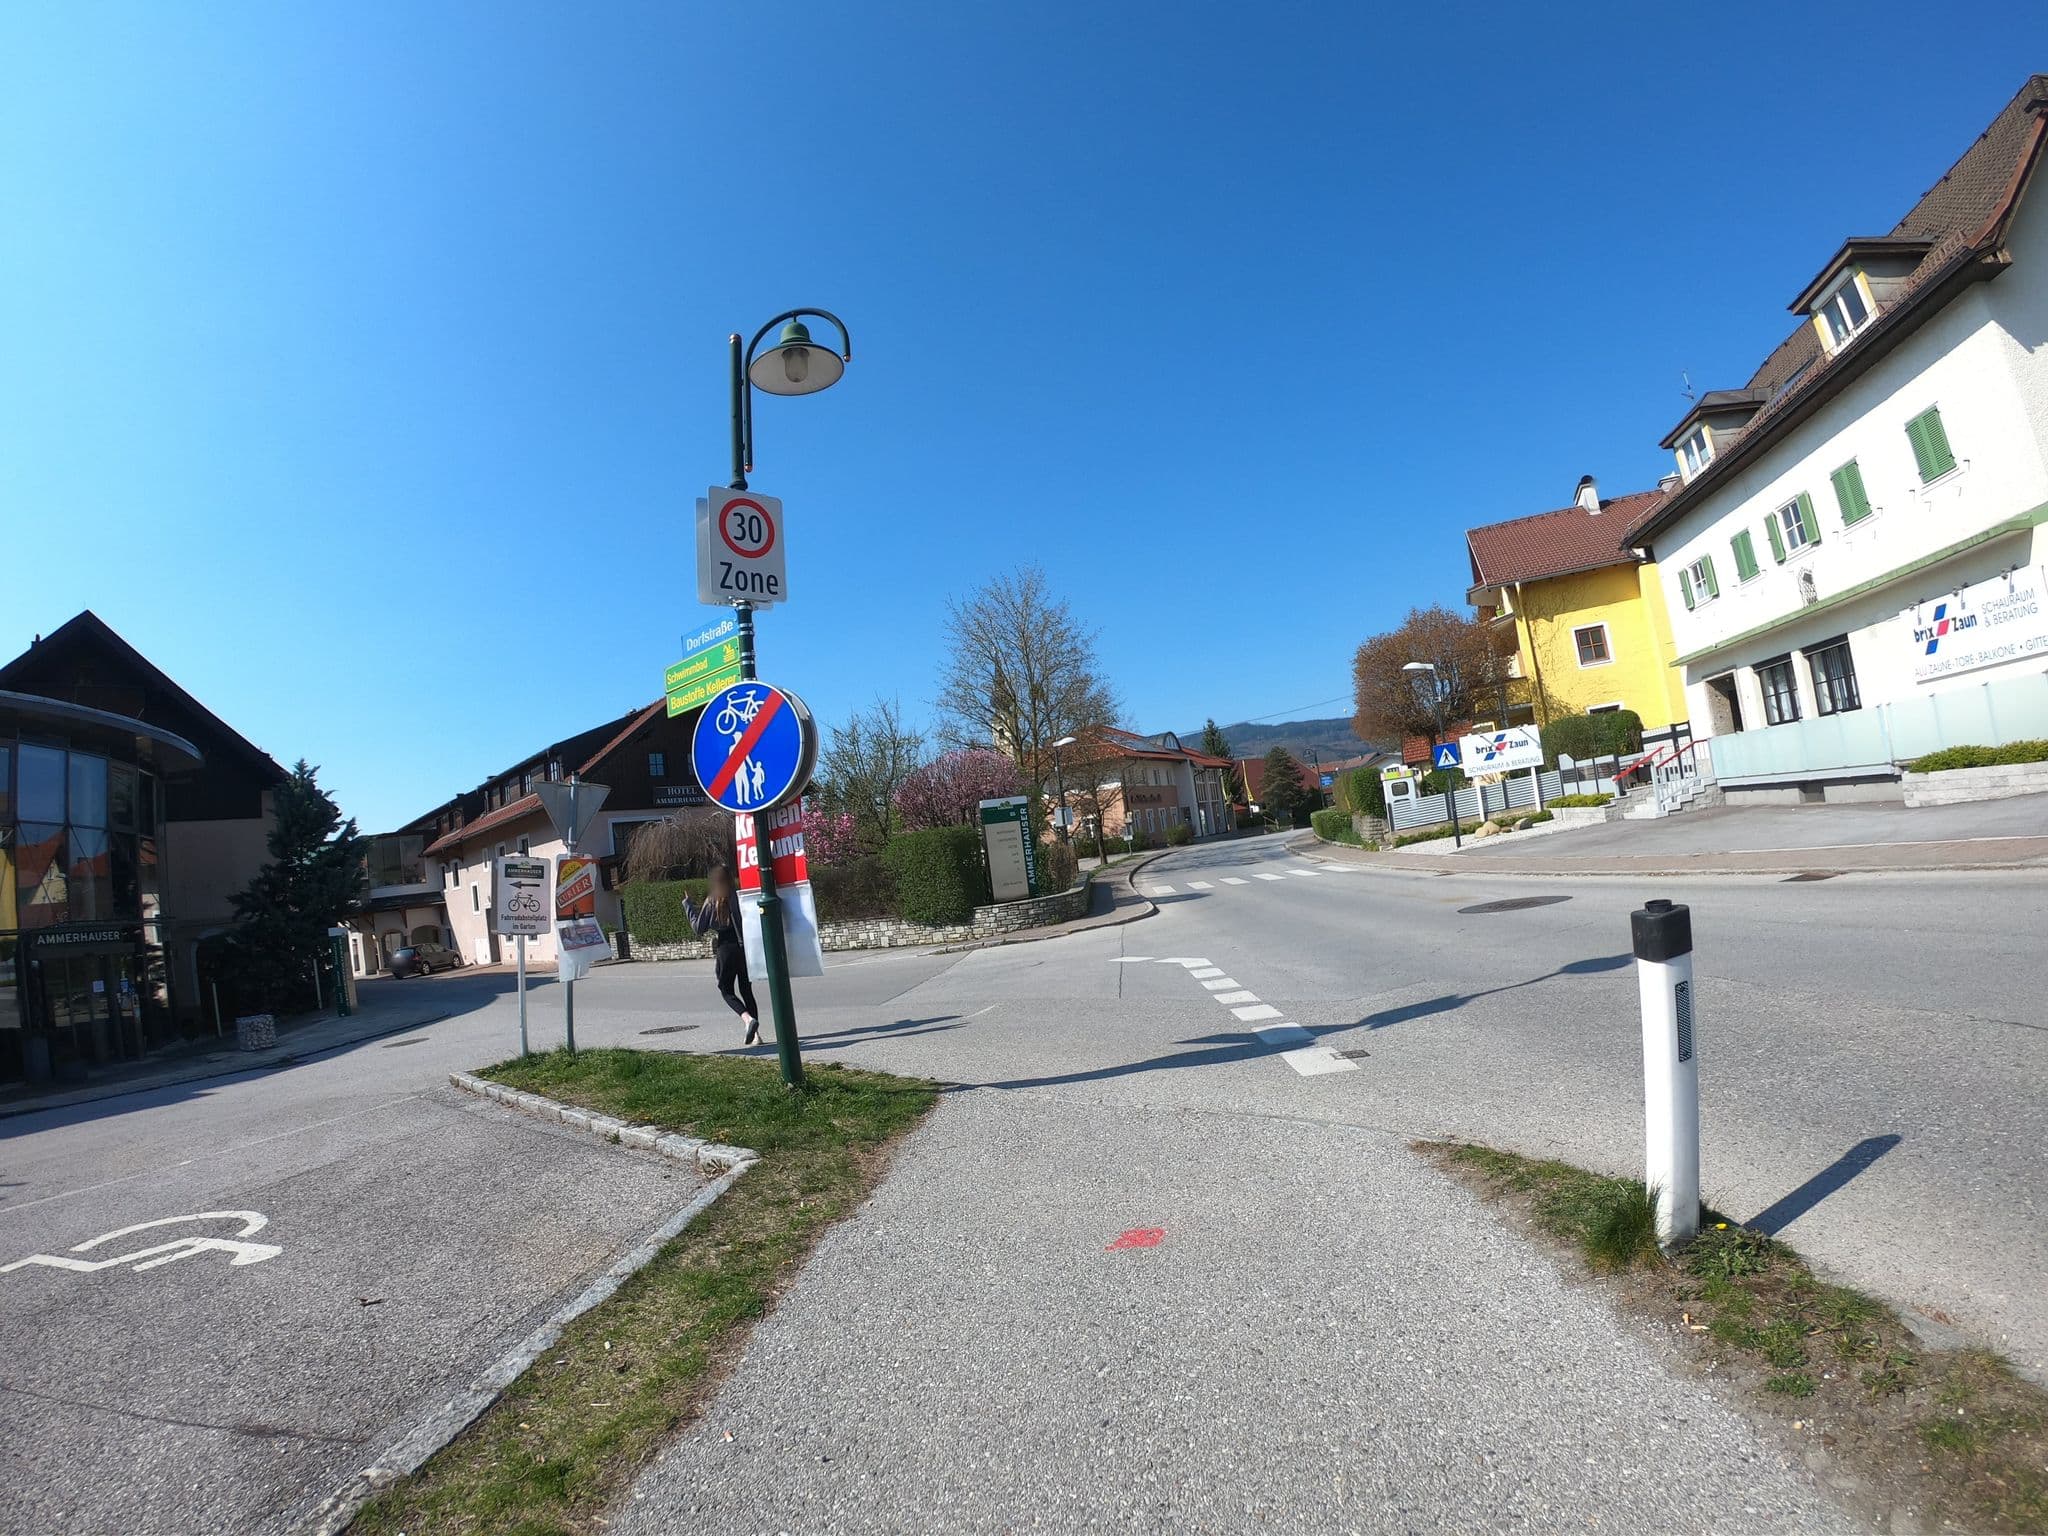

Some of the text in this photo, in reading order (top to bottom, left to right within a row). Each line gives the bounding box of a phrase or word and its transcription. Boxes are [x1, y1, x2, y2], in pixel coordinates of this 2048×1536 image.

[733, 513, 762, 544] 30
[720, 561, 779, 595] Zone
[1981, 587, 2036, 615] SCHAURAUM
[1984, 602, 2039, 628] & BERATUNG
[686, 620, 734, 651] Dorfstraße
[1913, 613, 1978, 643] brix Zaun
[667, 656, 708, 685] Schwimmbad
[670, 686, 706, 710] Baustoffe
[1476, 739, 1529, 754] brix Zaun
[667, 787, 697, 796] HOTEL
[1020, 807, 1037, 885] AMMERHAUSER
[37, 930, 121, 945] AMMERHAUSER
